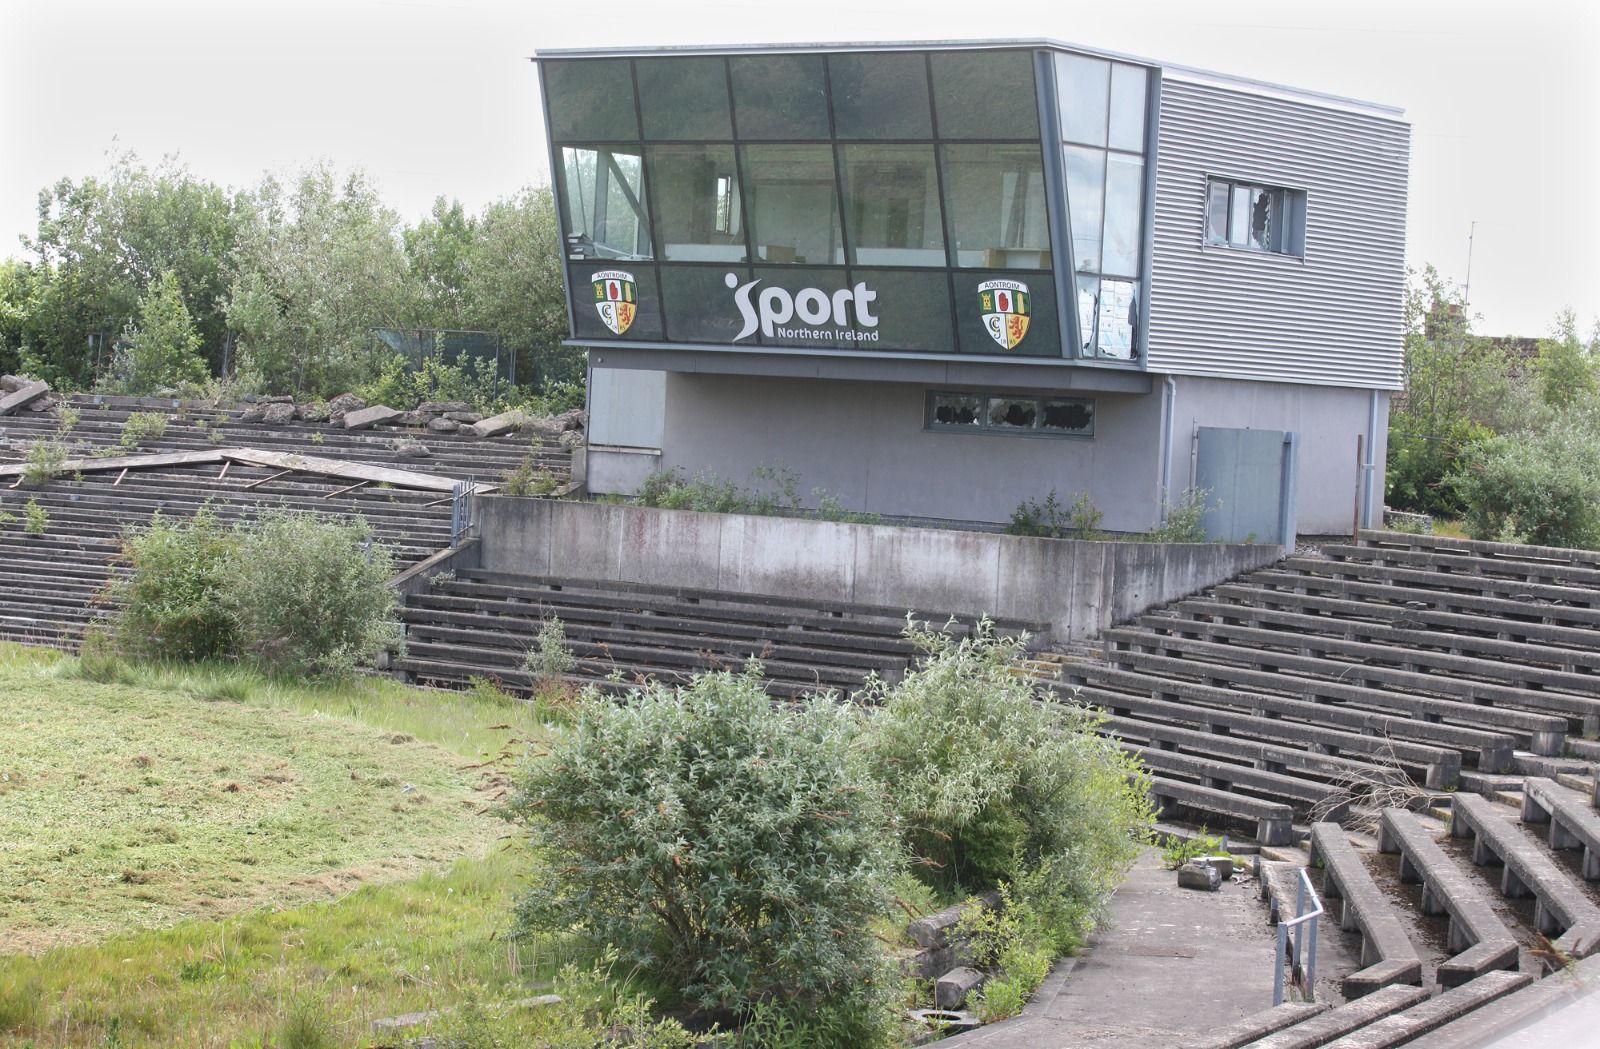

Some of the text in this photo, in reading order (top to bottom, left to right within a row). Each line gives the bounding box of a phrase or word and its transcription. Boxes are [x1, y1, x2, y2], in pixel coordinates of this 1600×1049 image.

[984, 281, 1020, 290] AONTROIM
[777, 327, 879, 341] Northern Ireland
